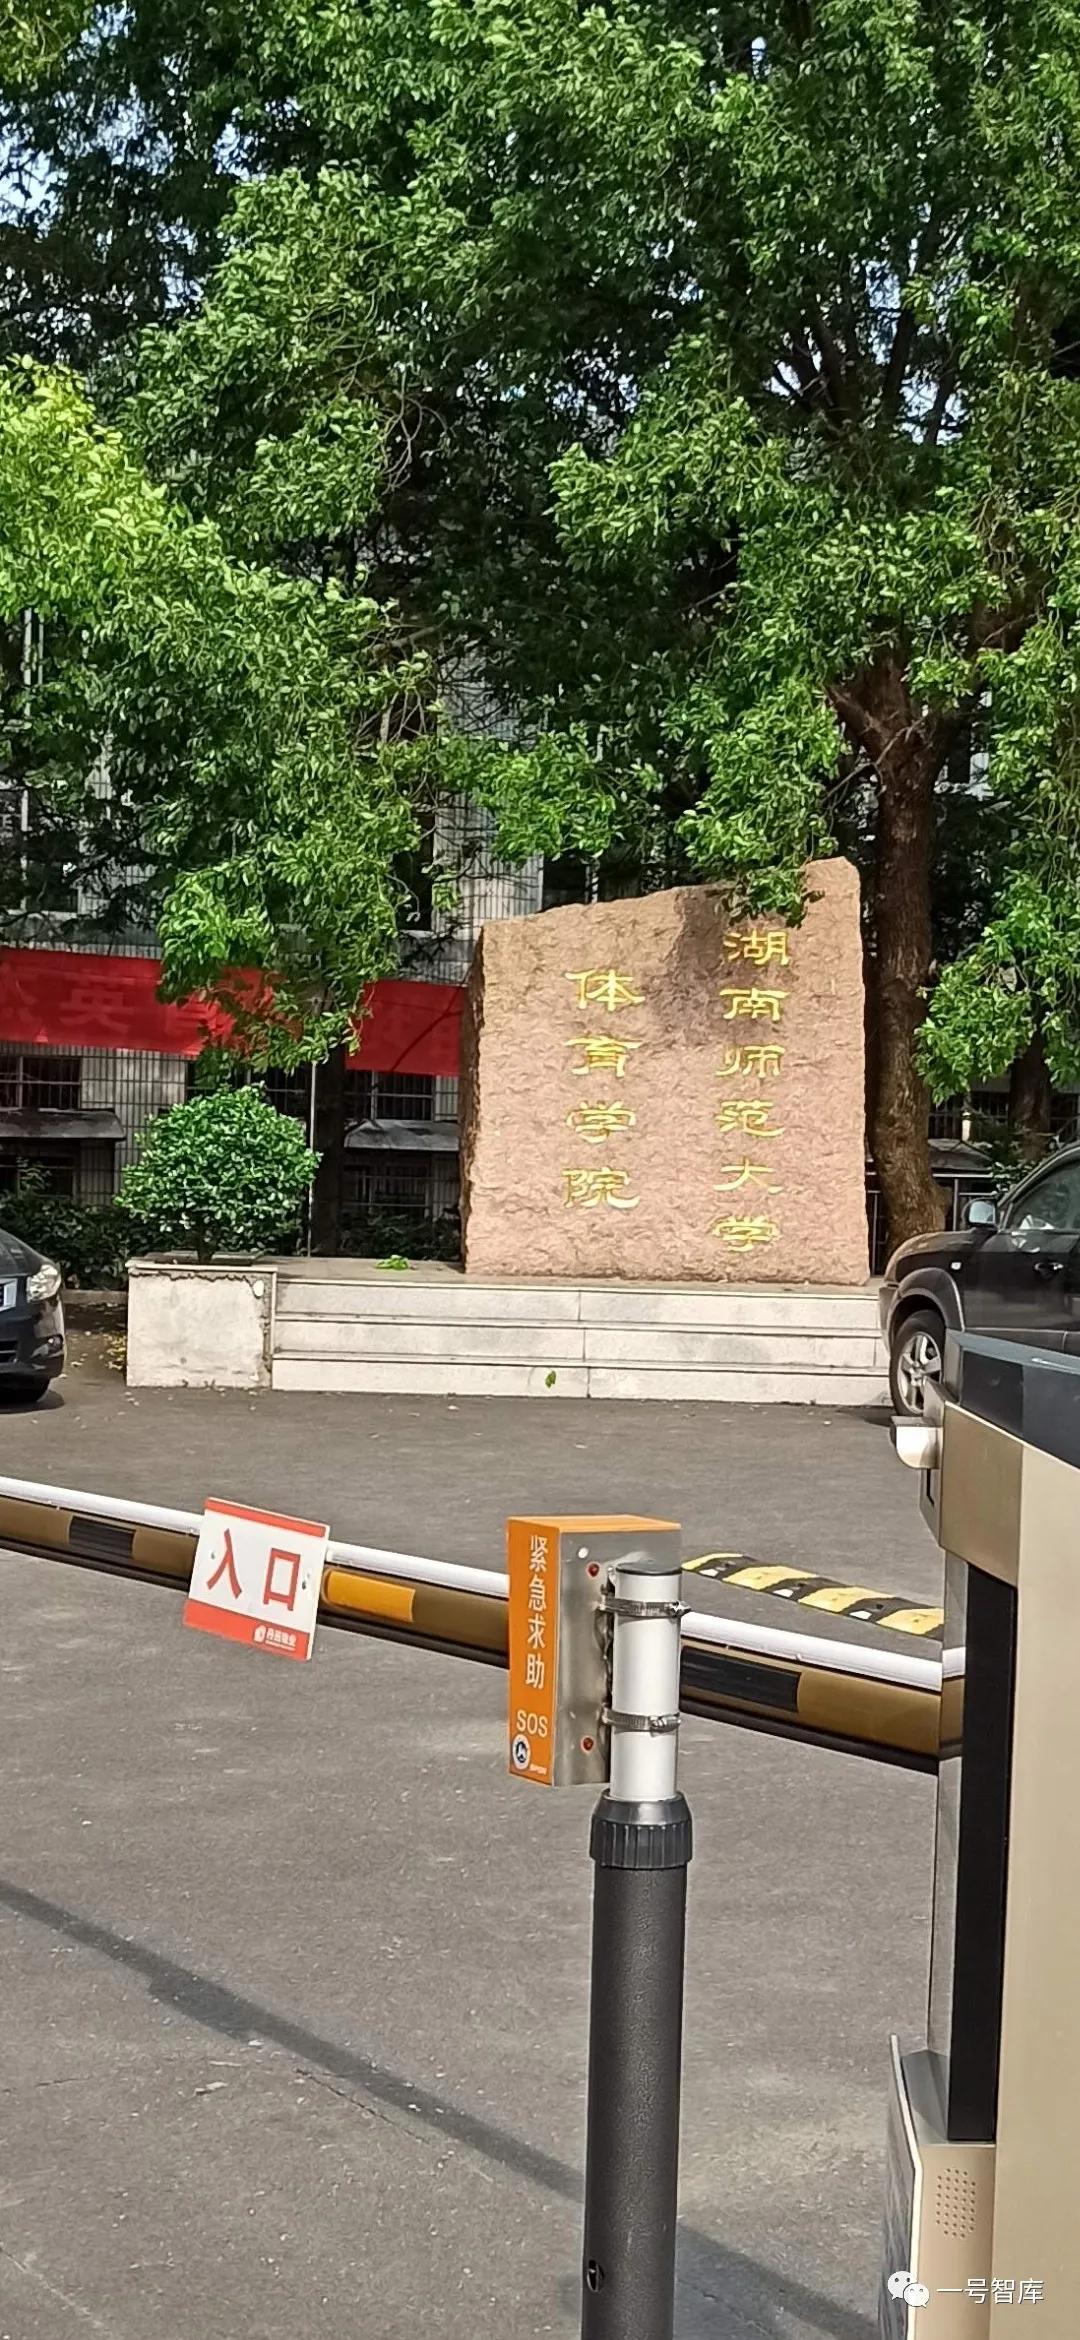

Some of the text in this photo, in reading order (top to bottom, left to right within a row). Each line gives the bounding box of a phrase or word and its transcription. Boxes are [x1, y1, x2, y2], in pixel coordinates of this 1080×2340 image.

[561, 968, 646, 1209] 体育学院
[712, 930, 791, 1253] 湖南师范大学
[206, 1528, 301, 1611] 入口
[525, 1535, 549, 1690] 紧急求助
[516, 1709, 549, 1738] SOS
